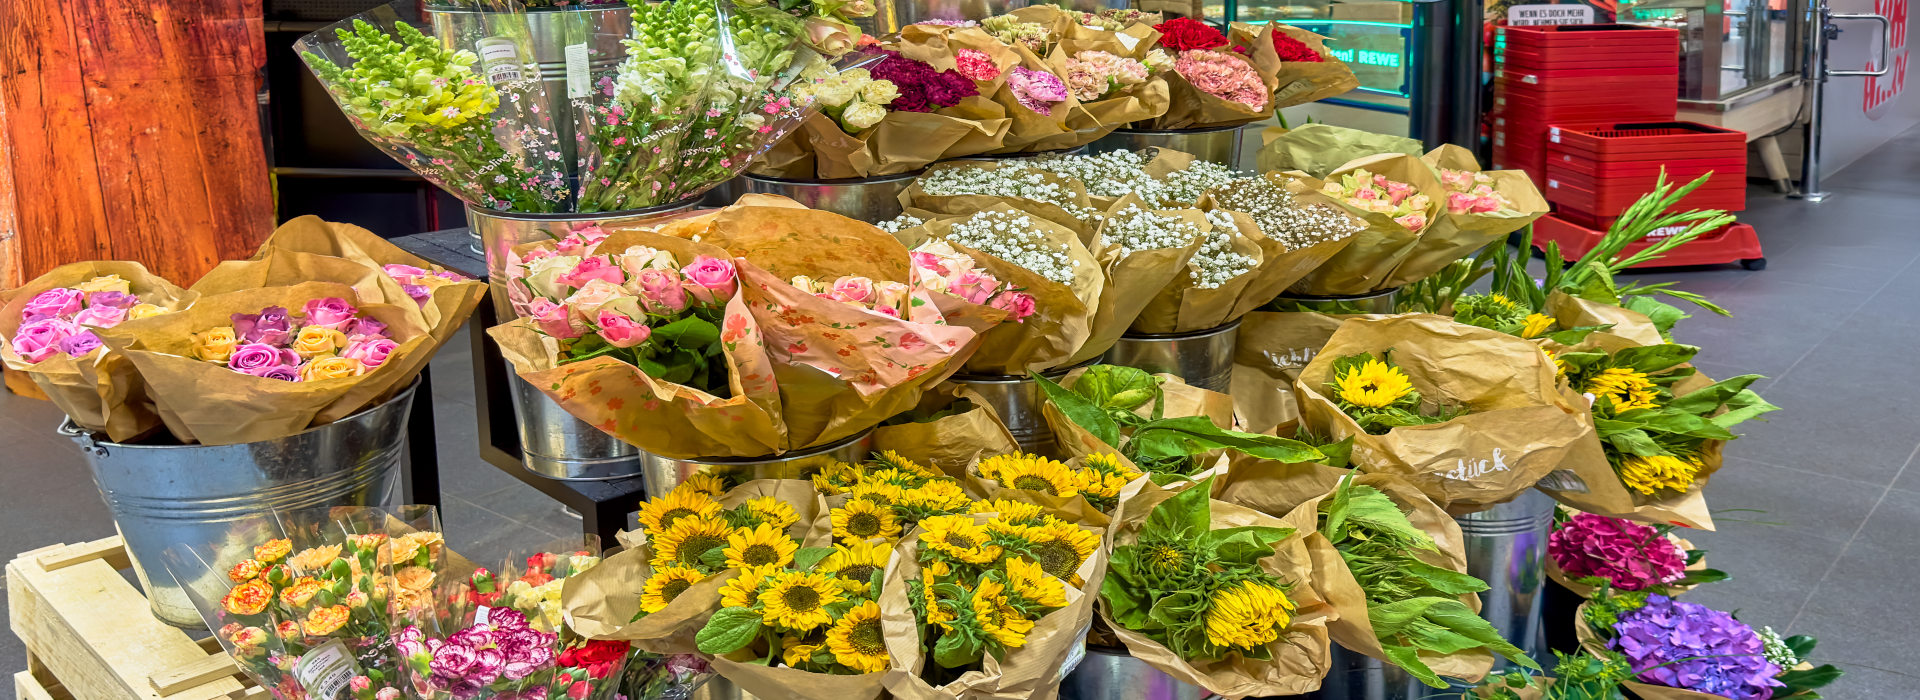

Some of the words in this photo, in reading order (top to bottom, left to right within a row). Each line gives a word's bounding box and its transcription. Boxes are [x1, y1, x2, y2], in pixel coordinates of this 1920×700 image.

[1519, 10, 1537, 18] WENN
[1540, 9, 1547, 18] ES
[1549, 9, 1565, 18] DOCH
[1567, 9, 1584, 17] MEHR
[1358, 49, 1400, 68] REWE
